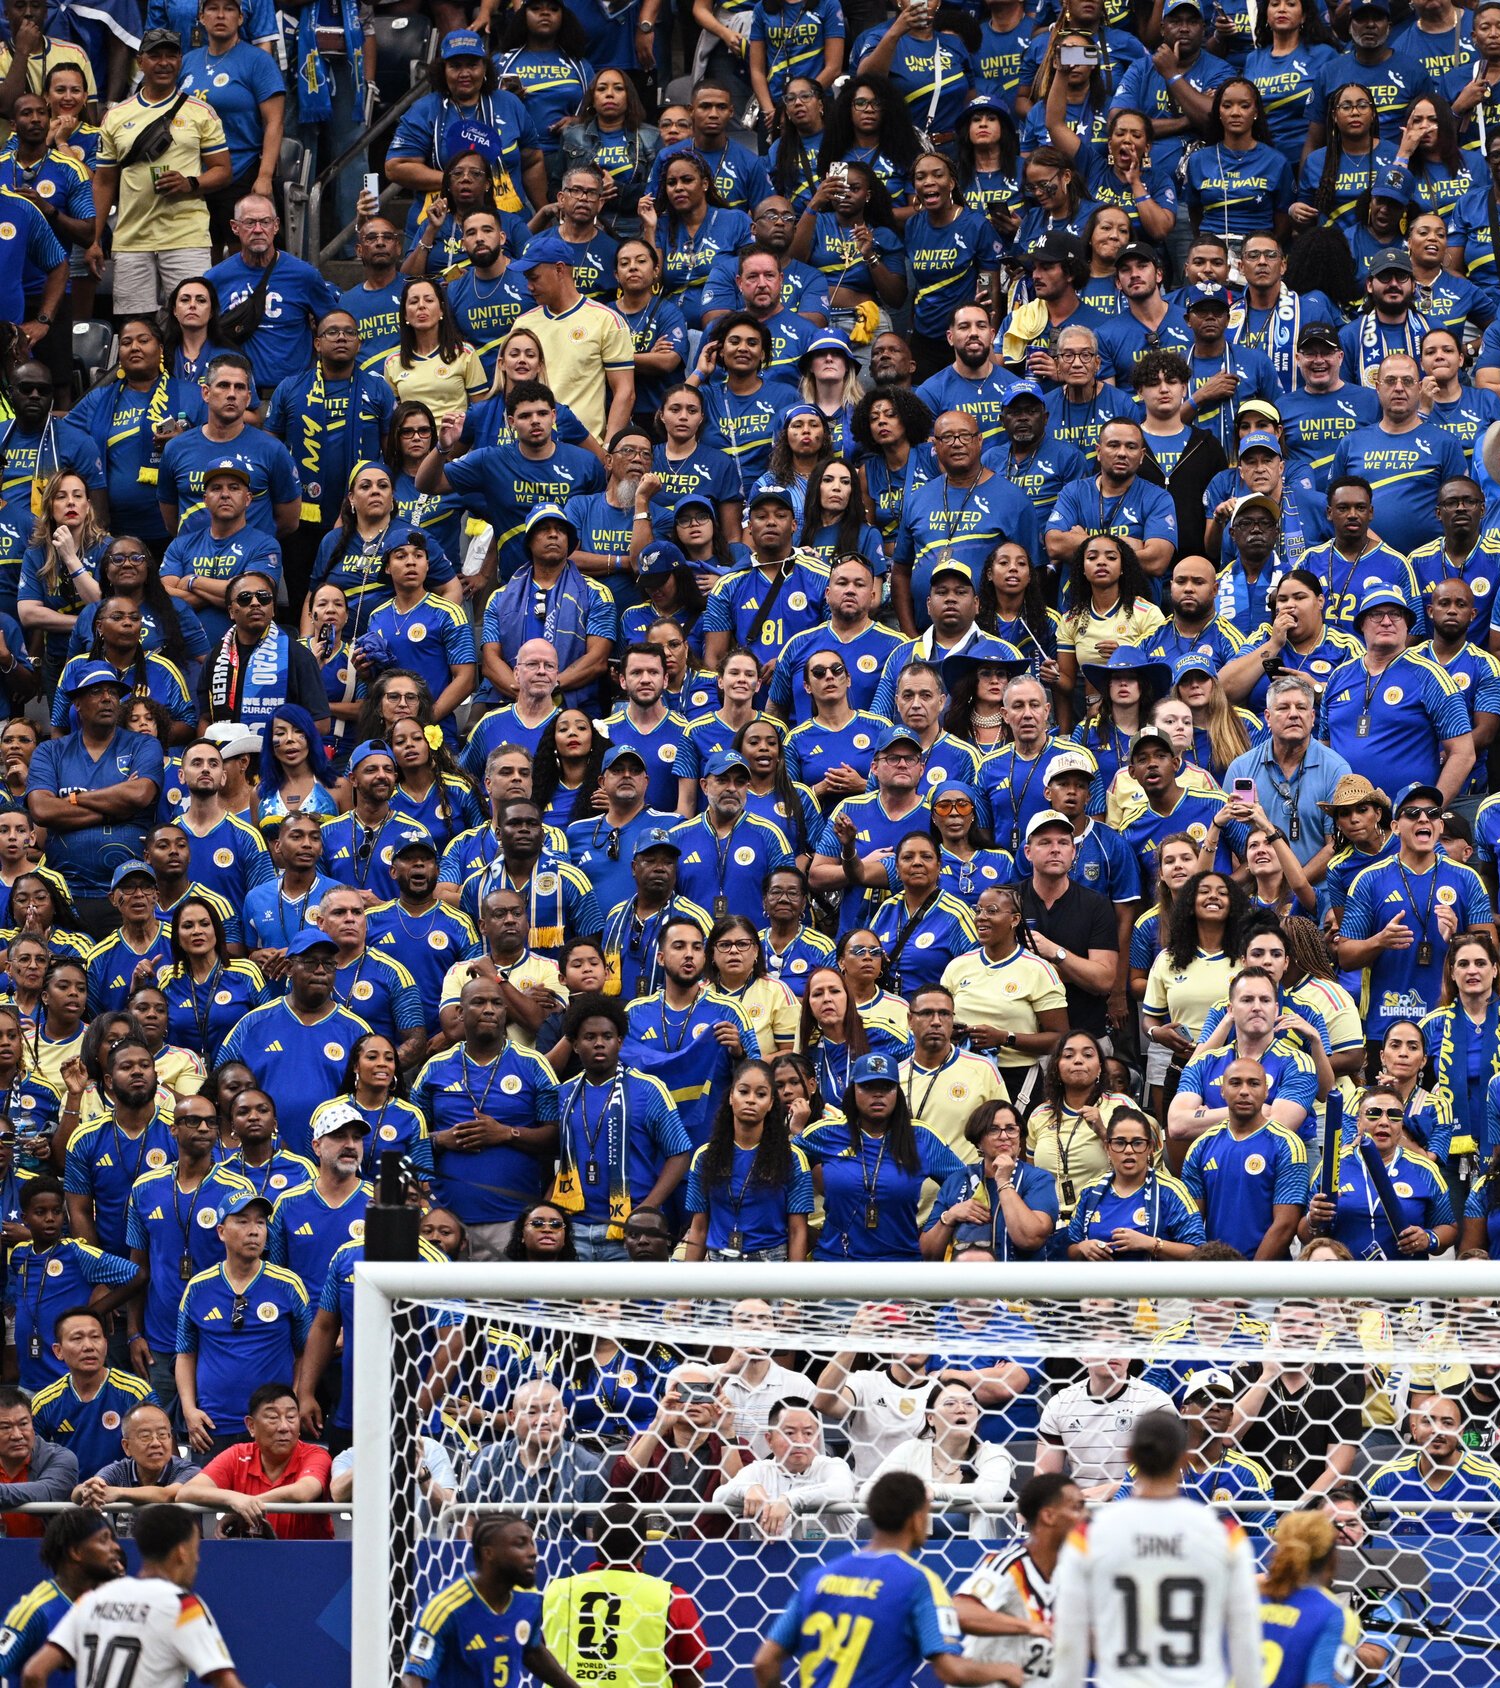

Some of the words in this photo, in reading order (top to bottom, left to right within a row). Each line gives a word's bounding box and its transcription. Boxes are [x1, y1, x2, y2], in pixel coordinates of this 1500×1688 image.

[516, 66, 571, 77] UNITED
[1254, 73, 1300, 87] UNITED
[1271, 83, 1296, 93] PLAY
[461, 131, 490, 147] ULTRA
[1200, 178, 1229, 191] BLUE
[1233, 177, 1268, 189] WAVE
[1418, 179, 1470, 193] UNITED
[1441, 189, 1467, 198] PLAY
[914, 249, 957, 260] UNITED
[913, 262, 926, 270] WE
[930, 261, 954, 269] PLAY
[468, 303, 521, 320] UNITED
[471, 320, 487, 329] WE
[720, 414, 770, 430] UNITED
[1299, 418, 1356, 432] UNITED
[740, 425, 766, 436] PLAY
[1302, 432, 1319, 441] WE
[1324, 431, 1350, 440] PLA
[1364, 451, 1419, 462] UNITED
[1364, 462, 1380, 470] WE
[1385, 462, 1415, 470] PLAY
[514, 481, 570, 495] UNITED
[516, 495, 533, 503] WE
[538, 496, 568, 505] PLAY
[929, 511, 982, 522] UNITED
[930, 523, 946, 531] WE
[193, 556, 237, 568] UNTED
[194, 568, 211, 577] WE
[1325, 593, 1357, 622] 22
[761, 618, 783, 645] 81
[212, 625, 237, 706] GERM
[242, 698, 259, 706] WE
[1380, 1004, 1427, 1018] CURAÇAO
[1208, 1373, 1219, 1384] C
[1113, 1576, 1205, 1667] 19
[801, 1611, 874, 1688] 24
[83, 1633, 142, 1688] 10
[577, 1662, 600, 1671] WORLD
[493, 1655, 508, 1688] 5
[576, 1669, 617, 1682] 2026
